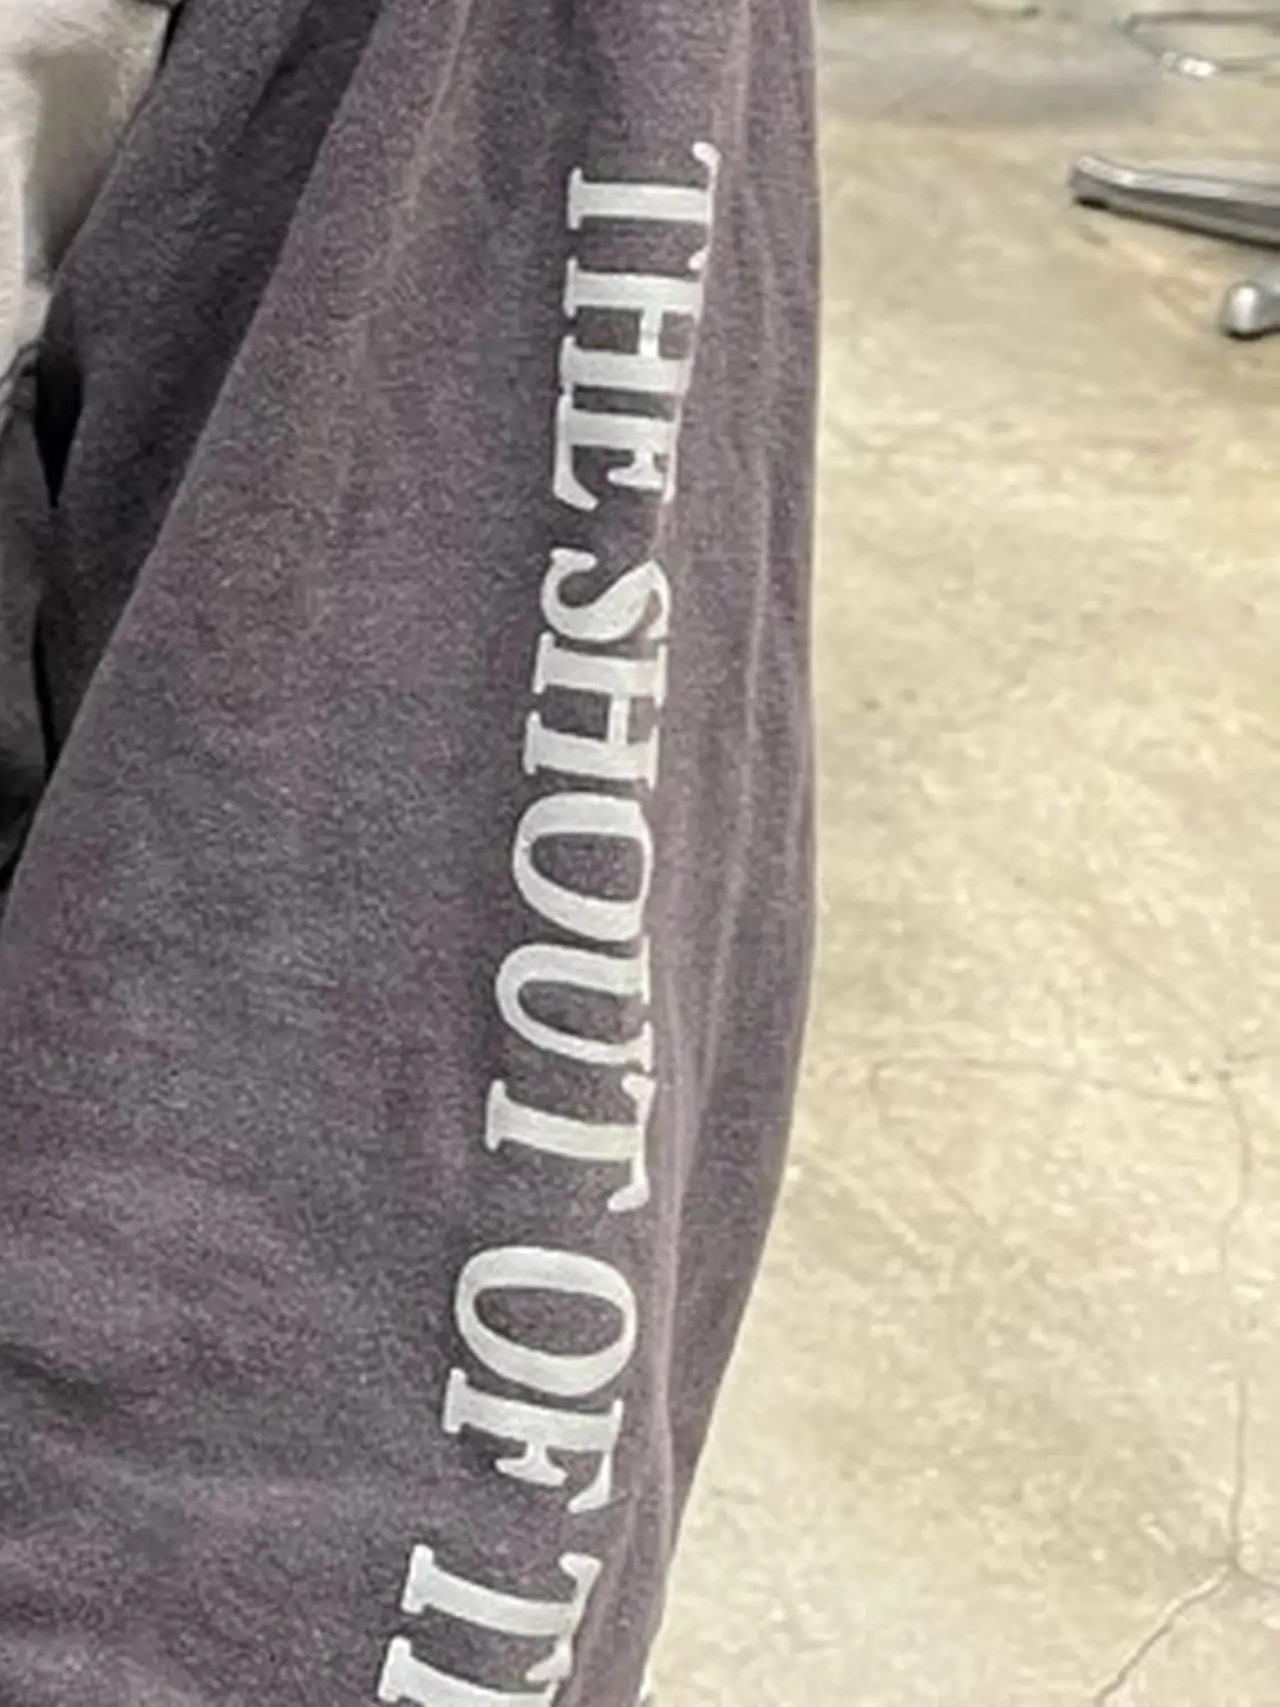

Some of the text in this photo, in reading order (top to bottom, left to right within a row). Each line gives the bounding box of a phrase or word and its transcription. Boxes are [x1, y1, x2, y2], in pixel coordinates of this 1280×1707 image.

[552, 140, 721, 511] THE
[485, 547, 671, 1213] SHOUT
[442, 1245, 638, 1513] OF
